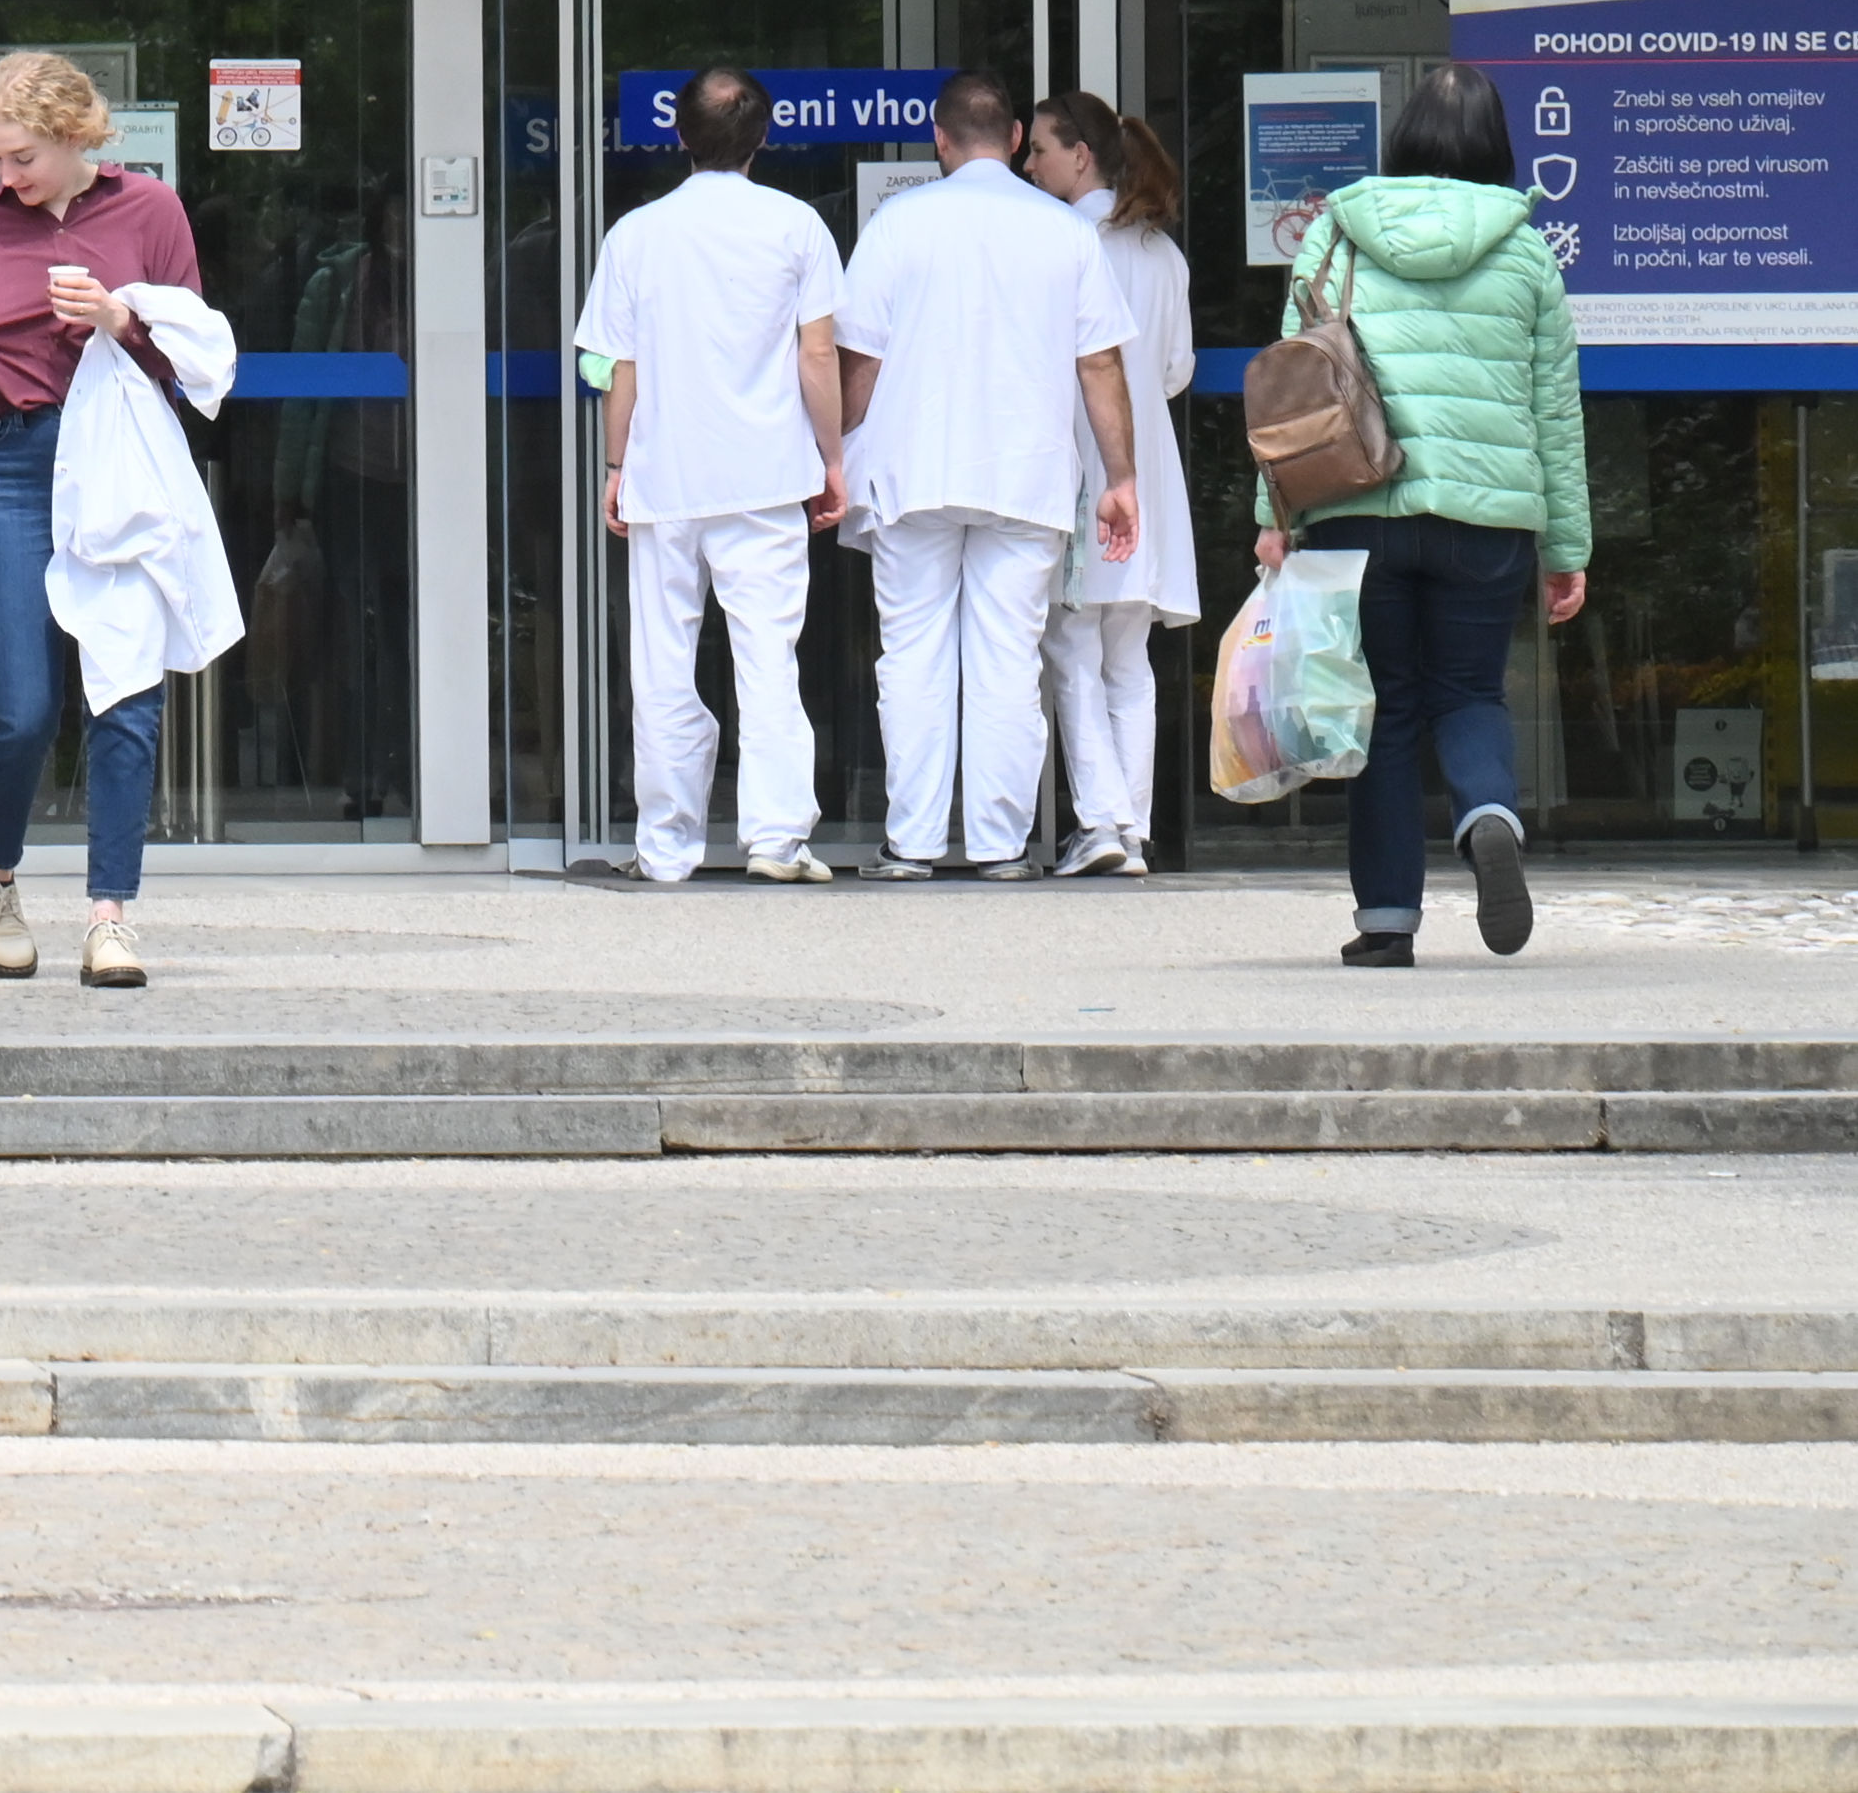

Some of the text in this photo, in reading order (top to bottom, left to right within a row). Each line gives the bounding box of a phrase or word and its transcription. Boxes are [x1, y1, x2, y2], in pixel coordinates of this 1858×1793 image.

[1535, 33, 1632, 53] POHODI
[1640, 32, 1755, 52] COVID-19
[1763, 32, 1788, 52] IN
[1795, 31, 1827, 52] SE
[1613, 88, 1826, 110] Znebi se vseh omejitev
[1614, 113, 1795, 135] in sproščeno uživaj.
[1613, 155, 1829, 177] Zaščiti se pred virusom
[1614, 180, 1769, 200] in nevšečnostmi.
[1613, 223, 1788, 244] Izboljšaj odpornost
[1613, 247, 1813, 270] in počni, kar te veseli.
